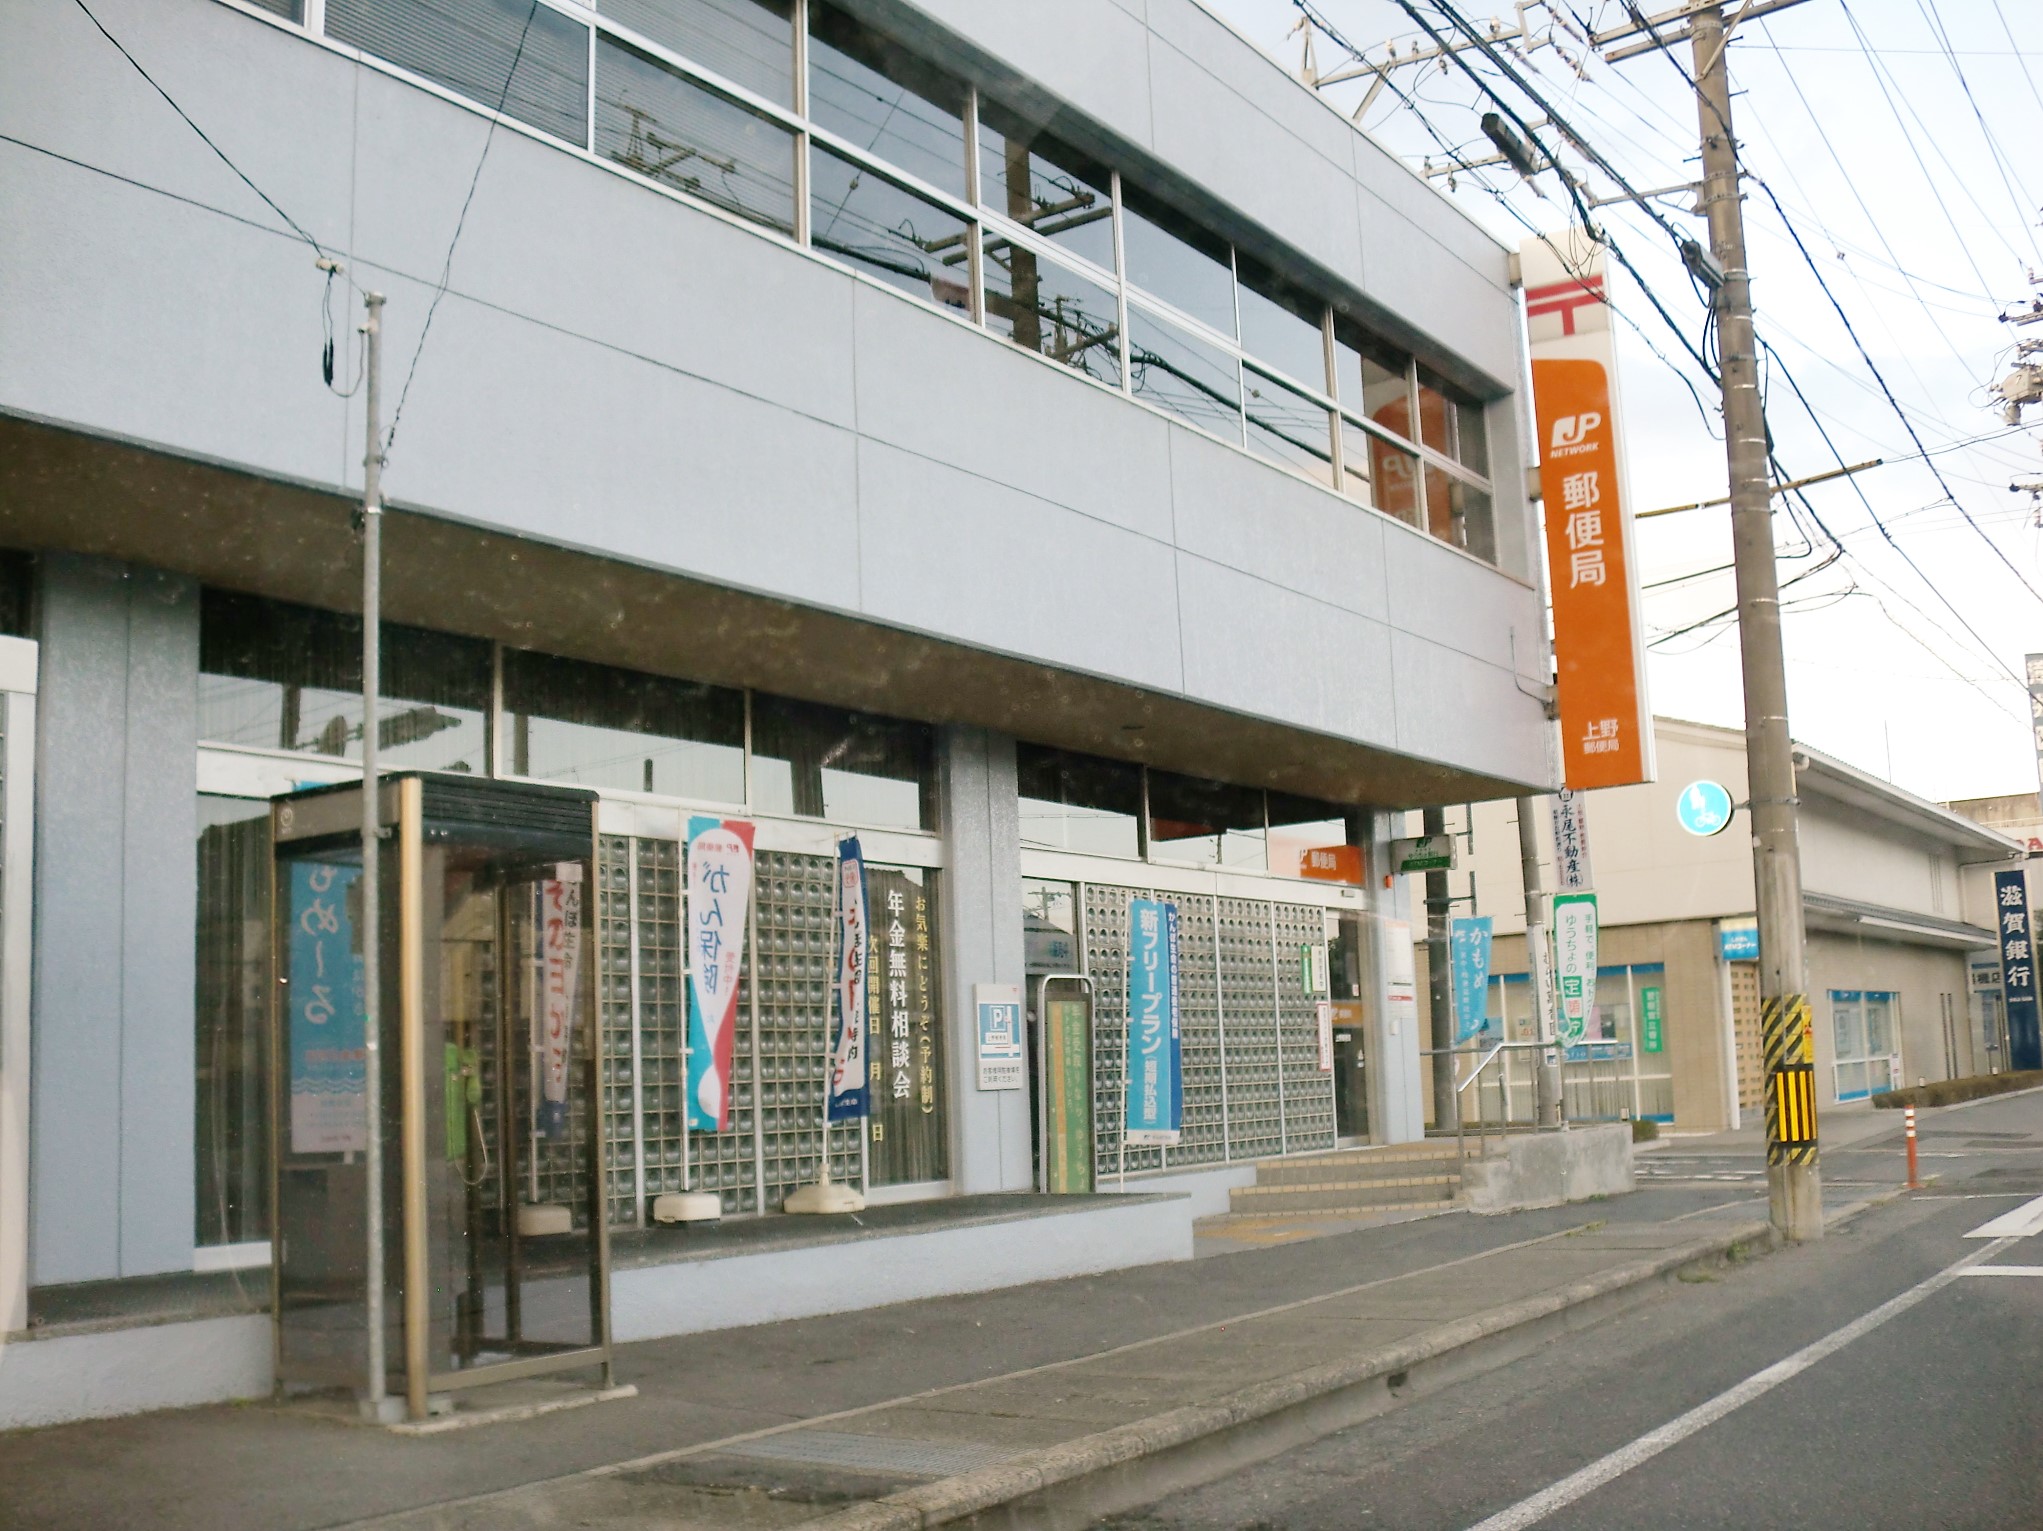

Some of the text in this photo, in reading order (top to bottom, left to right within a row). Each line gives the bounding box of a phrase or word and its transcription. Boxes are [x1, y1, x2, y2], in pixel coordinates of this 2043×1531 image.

[1551, 411, 1602, 448] JP
[1550, 442, 1599, 459] NETWORK
[1563, 471, 1606, 589] 郵便局
[1582, 718, 1618, 740] 上野
[1584, 739, 1619, 754] 郵便局
[1311, 850, 1337, 870] 郵便局
[2000, 885, 2031, 987] 滋賀銀行
[887, 889, 911, 1099] 年金無料相談会
[870, 1062, 881, 1081] 月
[872, 1124, 883, 1142] 日
